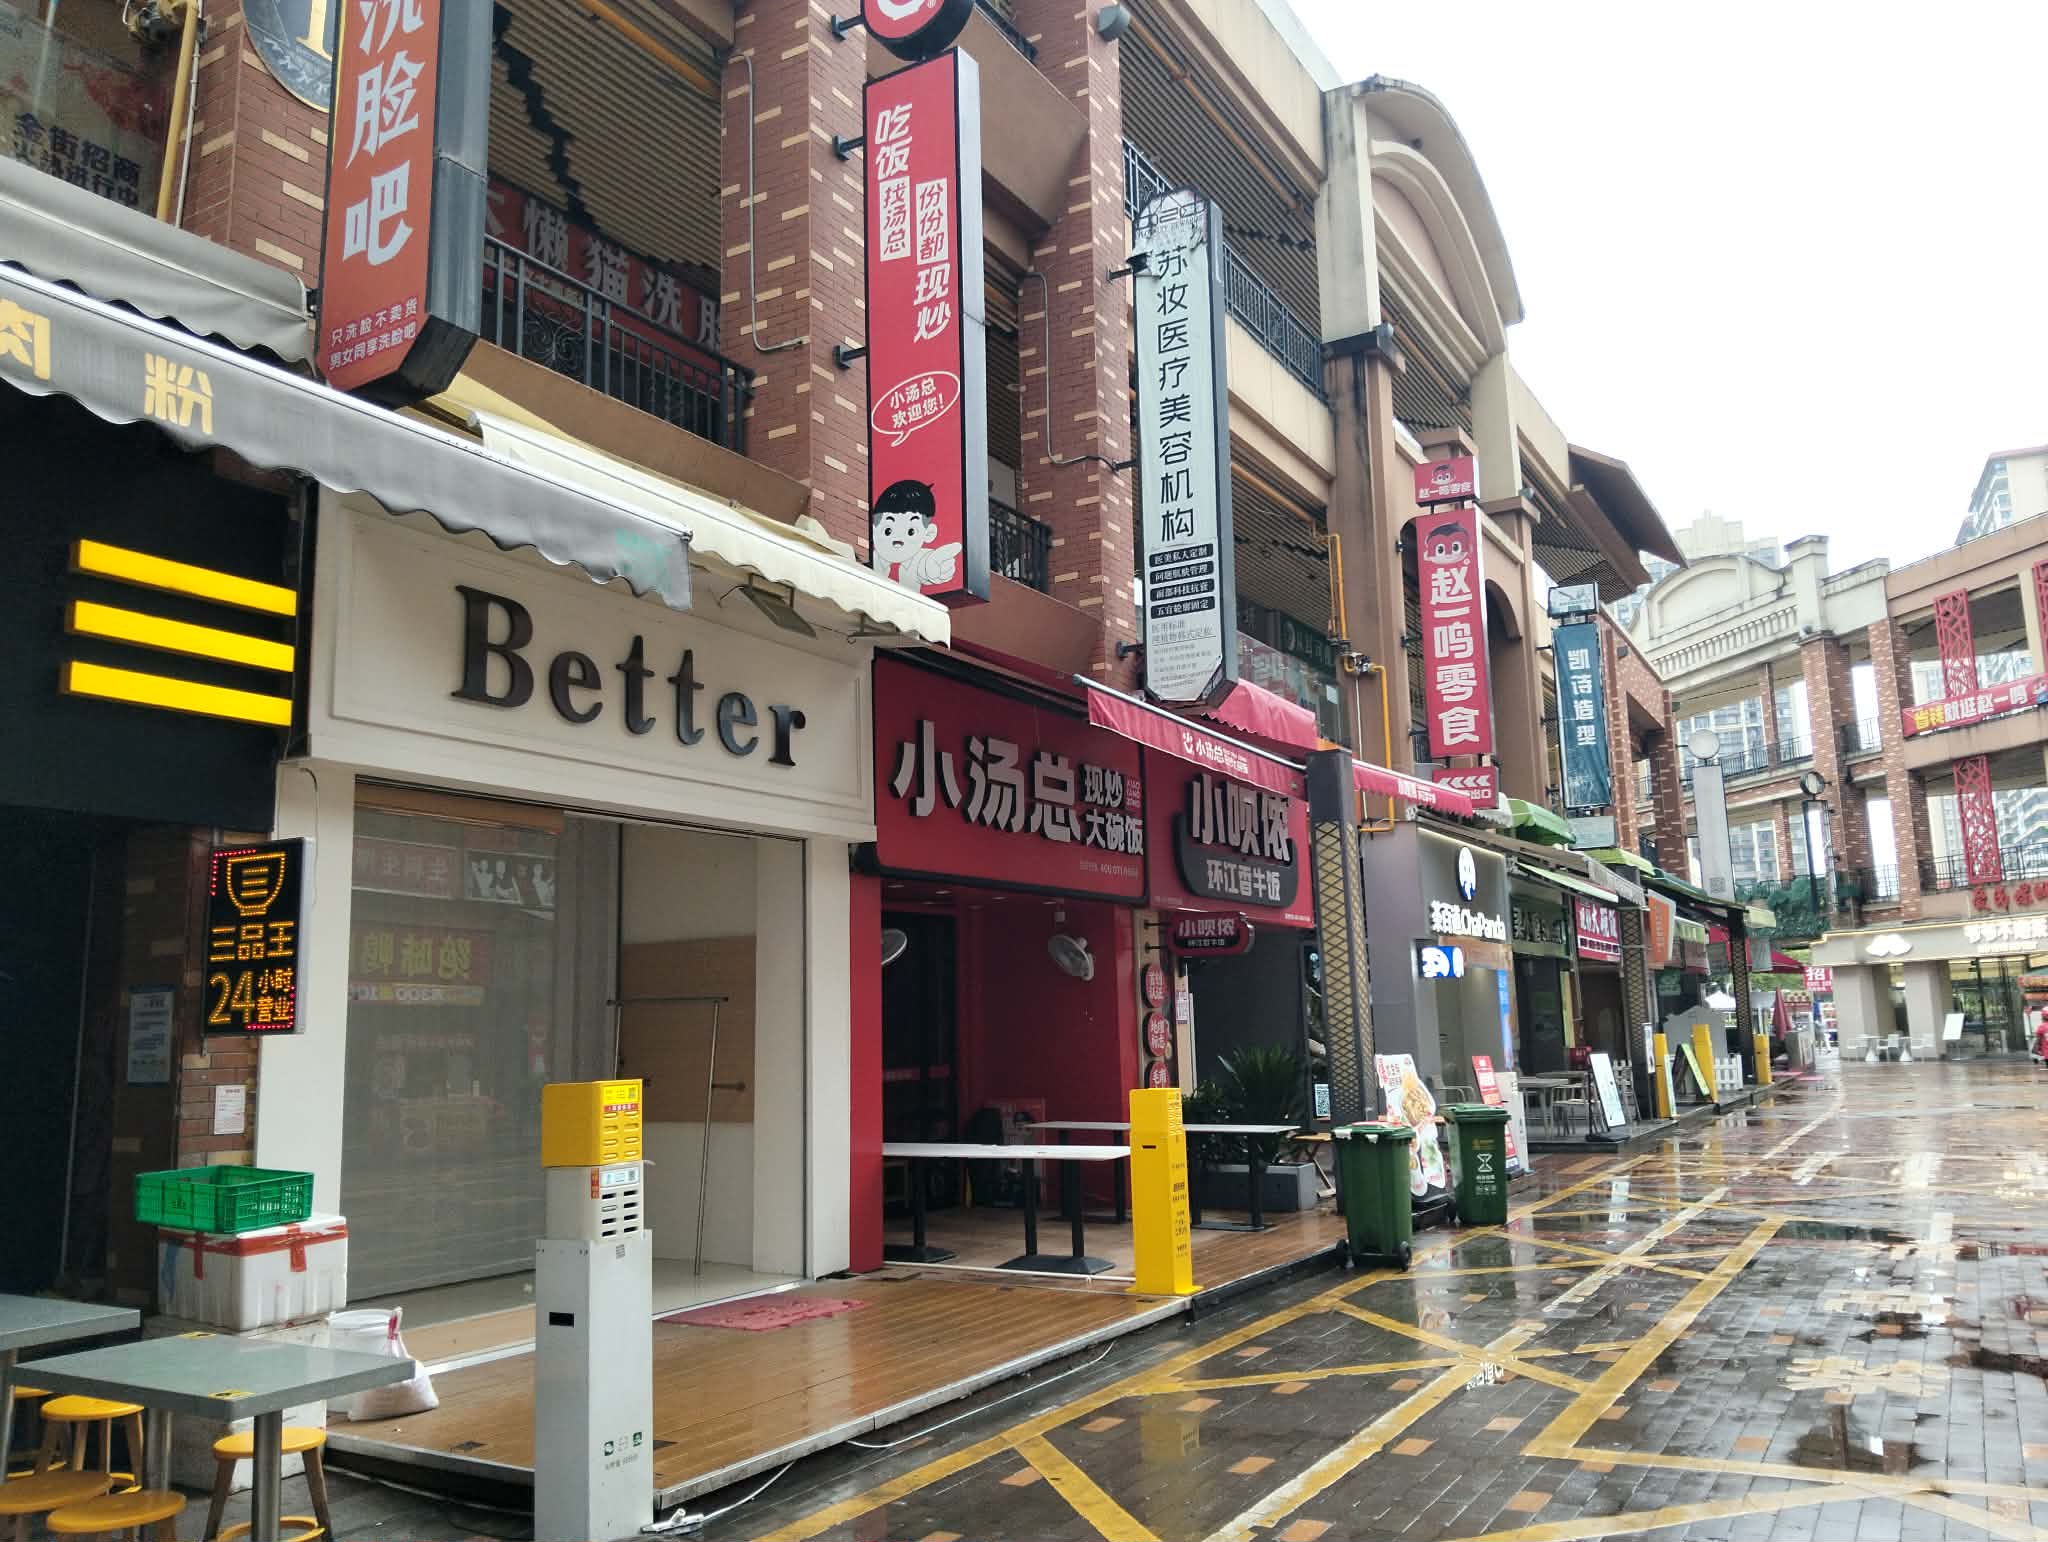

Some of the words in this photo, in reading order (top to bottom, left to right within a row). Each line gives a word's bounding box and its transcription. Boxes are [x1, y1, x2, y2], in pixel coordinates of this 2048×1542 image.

[875, 102, 913, 255] 吃饭找汤总
[913, 184, 952, 343] 份份都现炒
[889, 377, 937, 409] 小汤总
[1155, 244, 1195, 542] 苏妆医疗美容机构
[452, 584, 806, 767] Better
[1429, 565, 1480, 747] 赵一鸣零食
[891, 718, 1081, 843] 小汤总
[1083, 763, 1123, 808] 现炒
[1085, 809, 1144, 856] 大碗饭
[209, 920, 295, 961] 三品王
[208, 970, 256, 1024] 24
[257, 968, 294, 995] 小时
[1806, 967, 1825, 981] 招
[256, 995, 291, 1023] 营业
